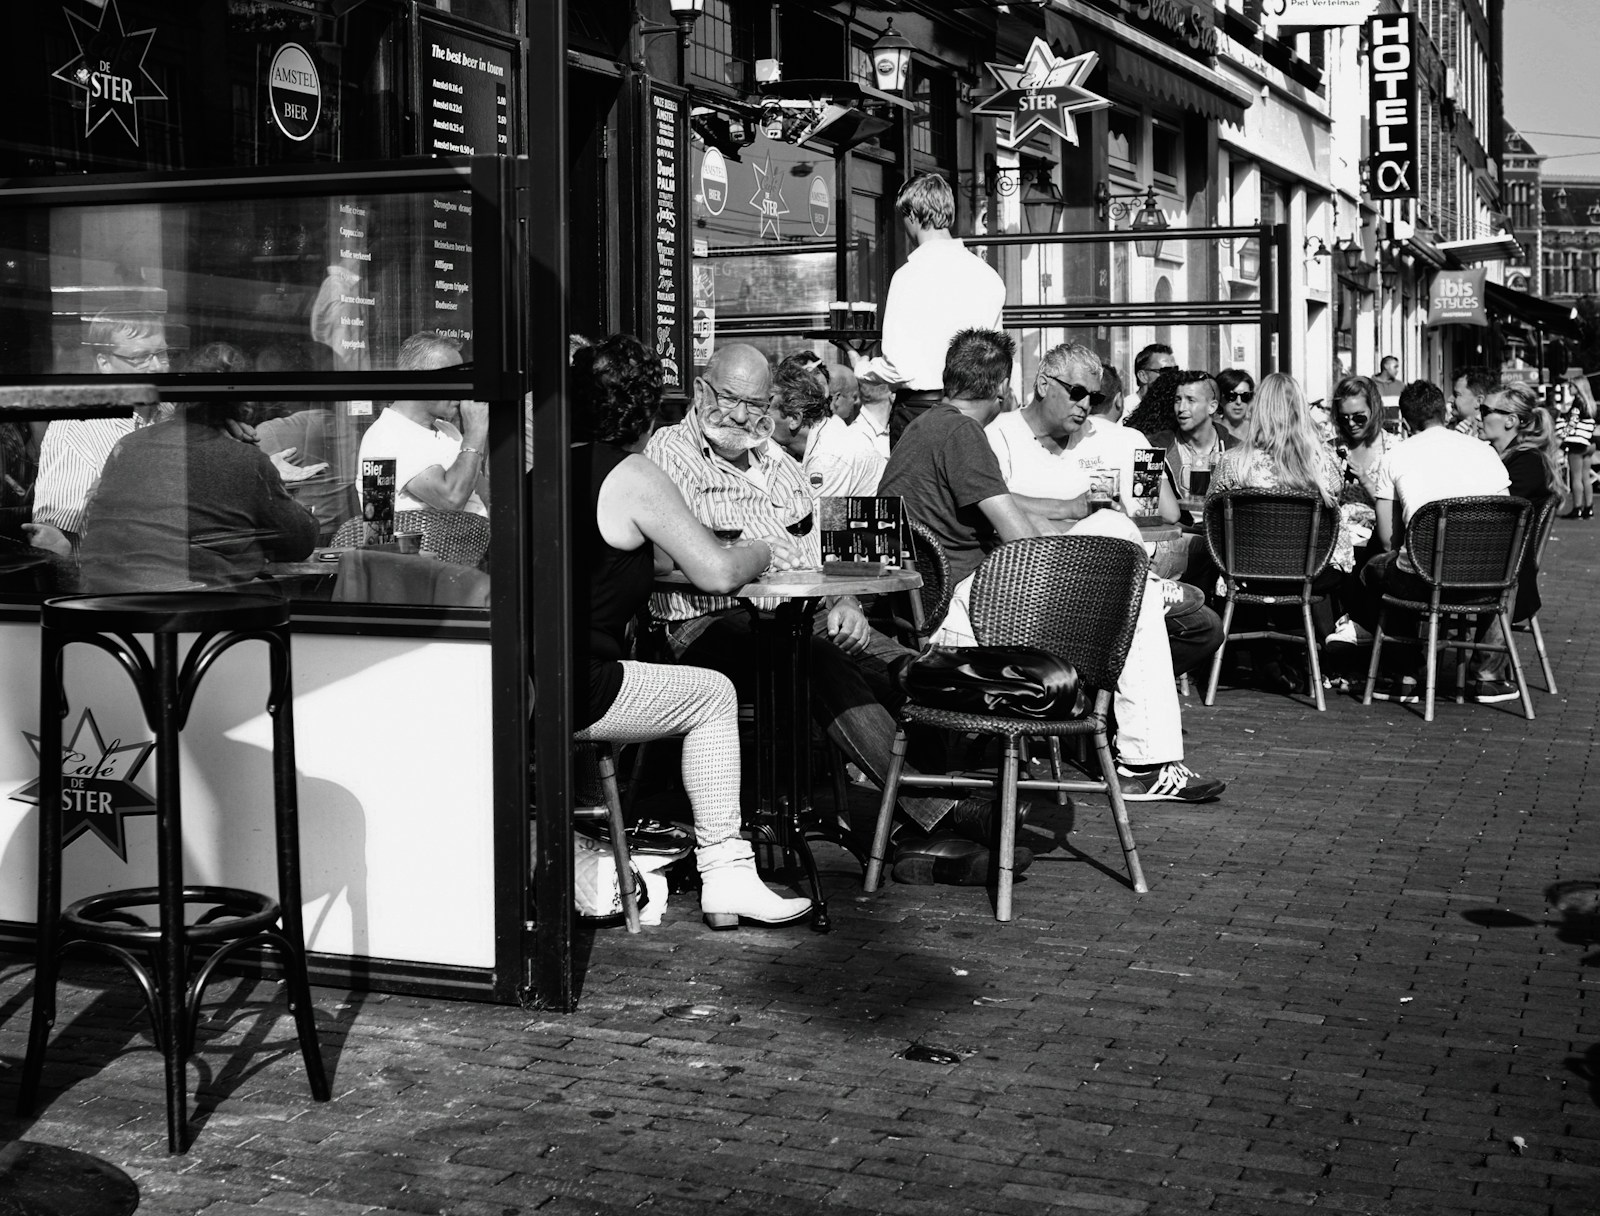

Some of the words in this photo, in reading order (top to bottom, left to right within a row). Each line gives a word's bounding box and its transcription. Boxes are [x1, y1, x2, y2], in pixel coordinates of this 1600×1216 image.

[100, 60, 110, 73] DE
[432, 44, 445, 60] The
[446, 48, 462, 65] best
[462, 53, 478, 69] beer
[479, 57, 486, 71] in
[487, 61, 504, 77] town
[275, 67, 315, 88] AMSTEL
[432, 79, 448, 90] Amstel
[91, 72, 134, 104] STER
[1372, 18, 1410, 152] HOTEL
[433, 99, 448, 111] Amstel
[1019, 94, 1057, 111] STER
[284, 102, 308, 121] BIER
[656, 108, 675, 123] AMSTEL
[433, 119, 449, 130] Amstel
[434, 139, 449, 150] Amstel
[450, 142, 460, 152] beer
[657, 148, 674, 159] ORVAL
[657, 176, 675, 192] PALM
[708, 188, 721, 201] BIER
[762, 199, 778, 216] STER
[815, 213, 825, 224] BIER
[1440, 279, 1473, 297] ibis
[1135, 450, 1154, 462] Bier
[363, 462, 383, 476] Bier
[1147, 461, 1163, 470] kaart
[377, 474, 394, 485] kaart
[62, 738, 120, 780] Café
[71, 778, 84, 789] DE
[62, 788, 113, 814] STER
